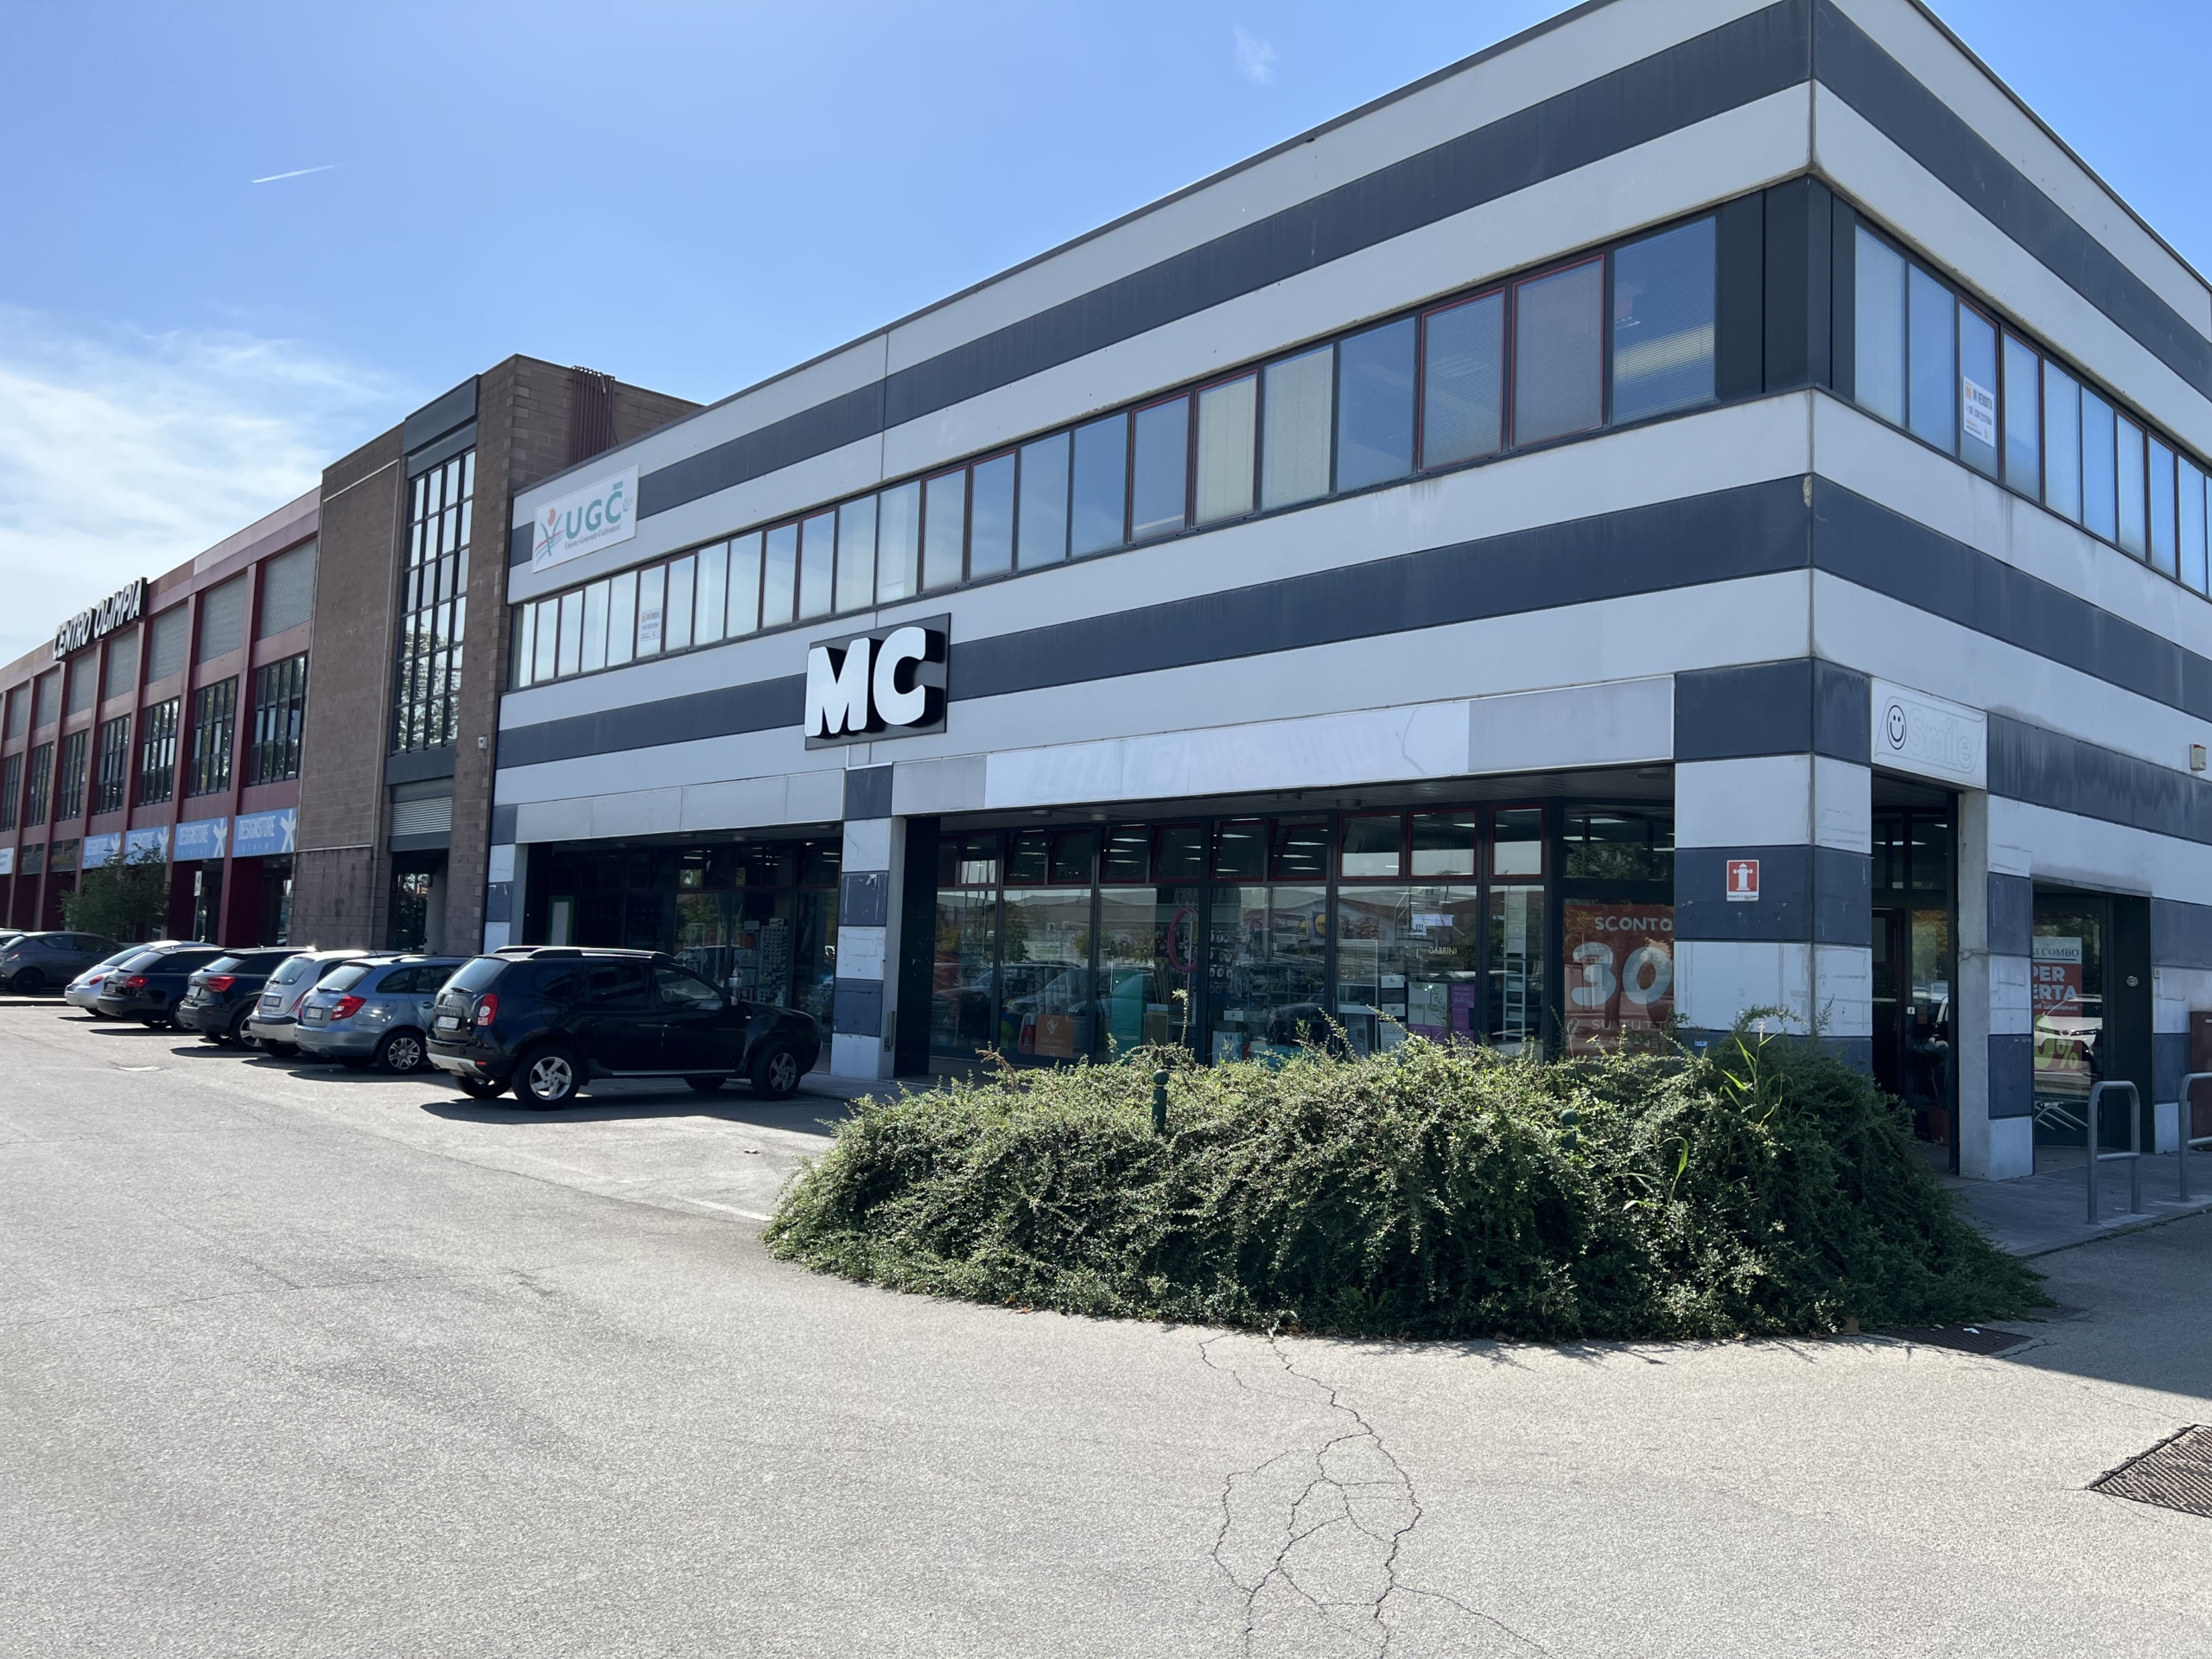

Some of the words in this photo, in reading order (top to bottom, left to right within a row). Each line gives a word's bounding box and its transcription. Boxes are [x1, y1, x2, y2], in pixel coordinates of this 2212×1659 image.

[566, 491, 622, 540] UGC
[53, 607, 92, 661] CENTRO
[94, 577, 143, 639] OLIMPIA
[804, 626, 926, 737] MC
[1909, 709, 1972, 769] Smile
[1594, 916, 1673, 931] SCONTO
[1427, 946, 1458, 956] GABRINI
[1571, 941, 1674, 1007] 30
[1592, 1020, 1611, 1030] SU
